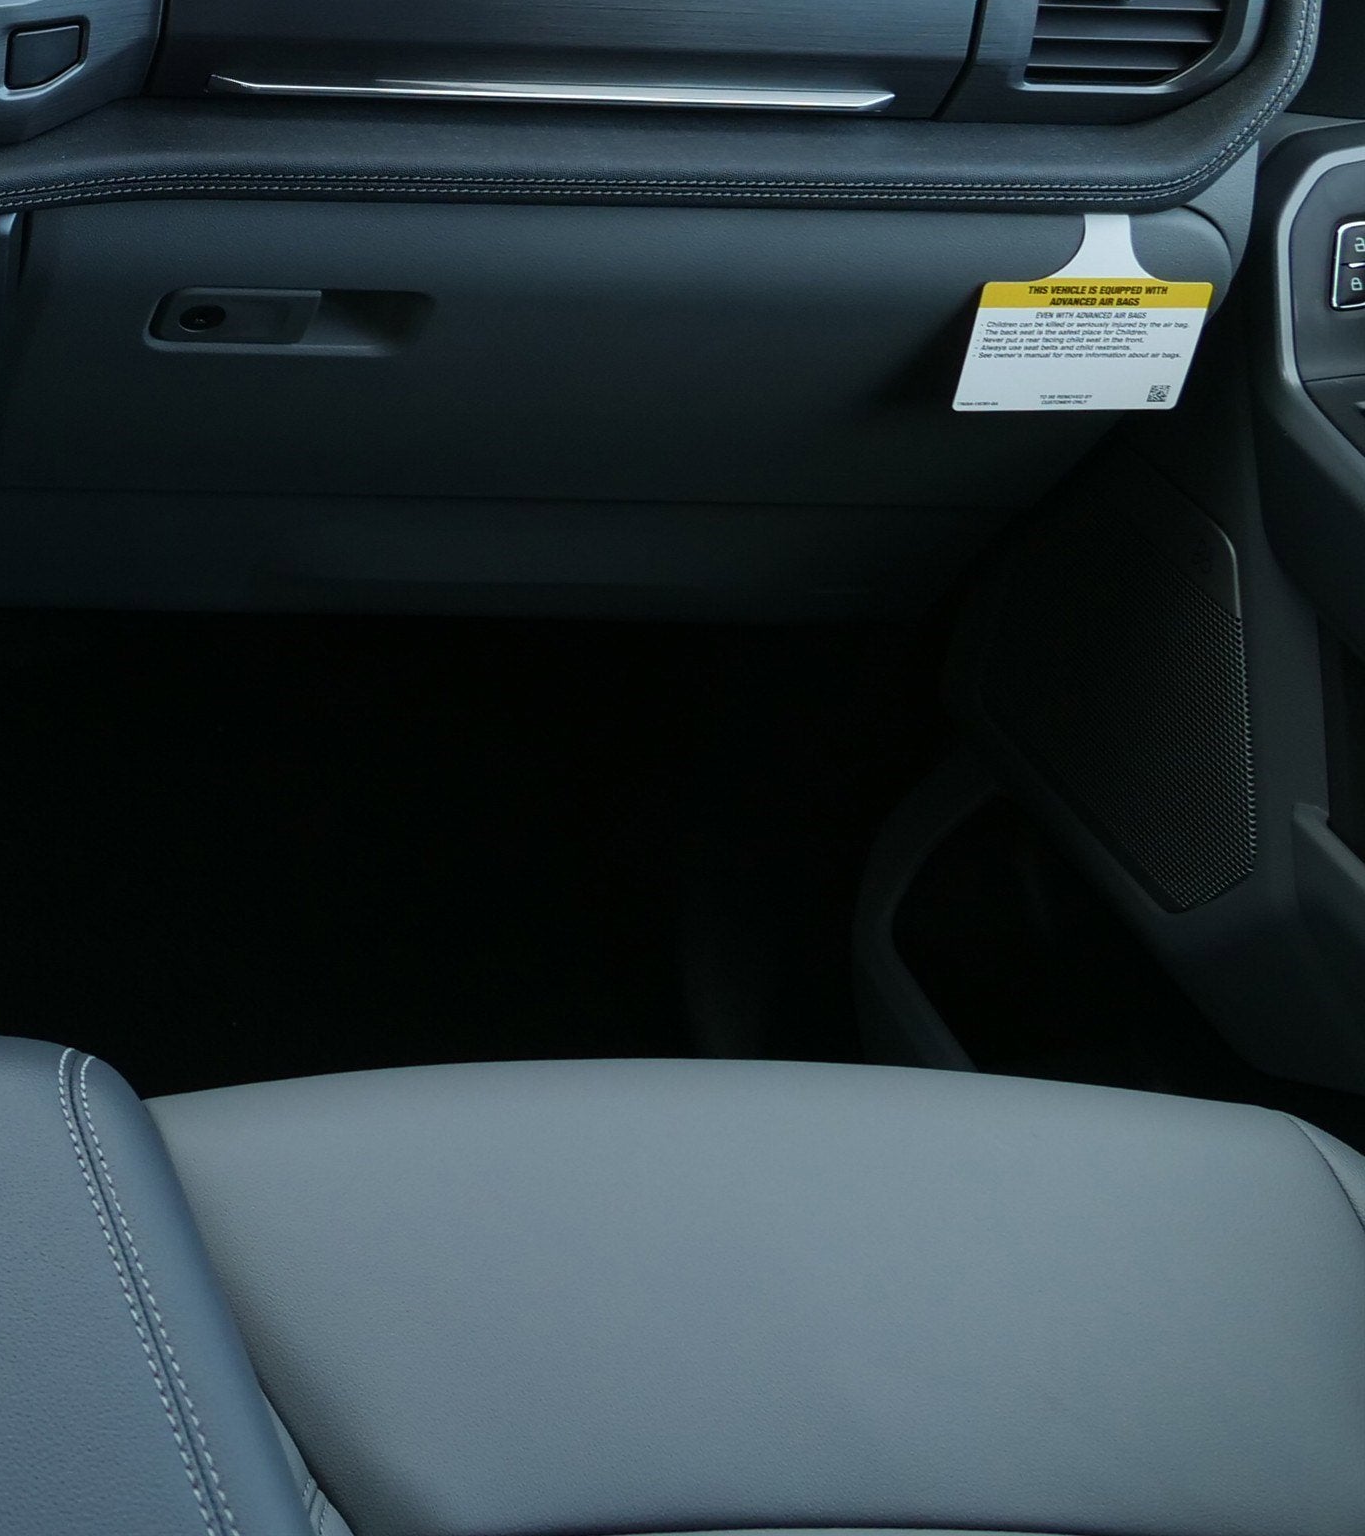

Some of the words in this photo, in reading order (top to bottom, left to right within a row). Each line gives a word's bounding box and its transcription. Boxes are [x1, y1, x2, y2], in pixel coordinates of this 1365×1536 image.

[1029, 286, 1048, 295] THIS
[1050, 286, 1086, 295] VEHICLE
[1088, 286, 1098, 295] IS
[1099, 286, 1142, 295] EQUIPPED
[1144, 286, 1168, 295] WITH
[1049, 297, 1097, 306] ADVANCED
[1099, 297, 1114, 306] AIR
[1116, 297, 1141, 306] BAGS
